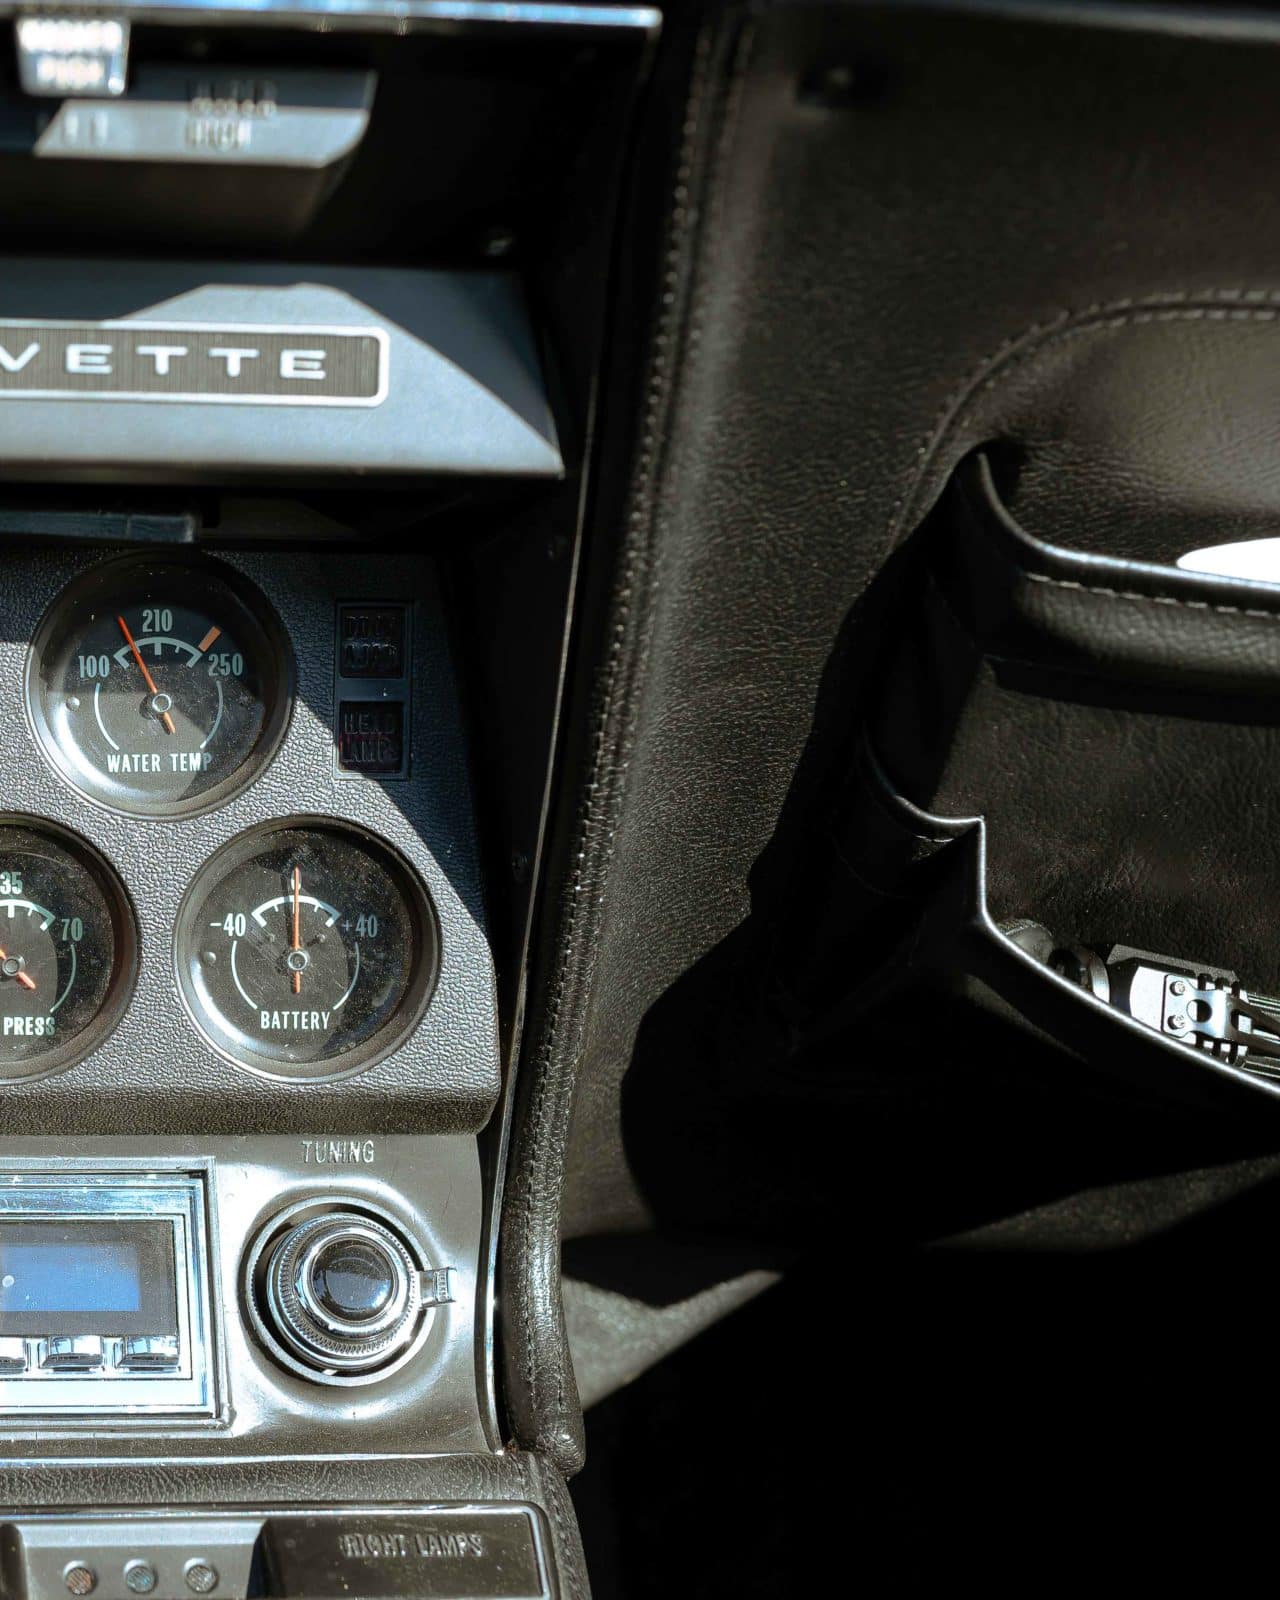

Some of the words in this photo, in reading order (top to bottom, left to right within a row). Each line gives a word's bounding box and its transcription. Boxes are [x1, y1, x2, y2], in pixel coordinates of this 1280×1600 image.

[142, 609, 173, 633] 210
[78, 655, 110, 679] 100
[208, 653, 244, 677] 250
[107, 753, 161, 774] WATER
[171, 751, 213, 772] TEMP
[0, 872, 23, 895] 35
[61, 918, 84, 942] 70
[210, 912, 246, 937] -40
[3, 1016, 55, 1036] PRESS
[260, 1010, 330, 1030] BATTERY
[302, 1140, 376, 1163] TUNING
[340, 1534, 407, 1557] RIGHT
[417, 1535, 485, 1556] LAMPS
